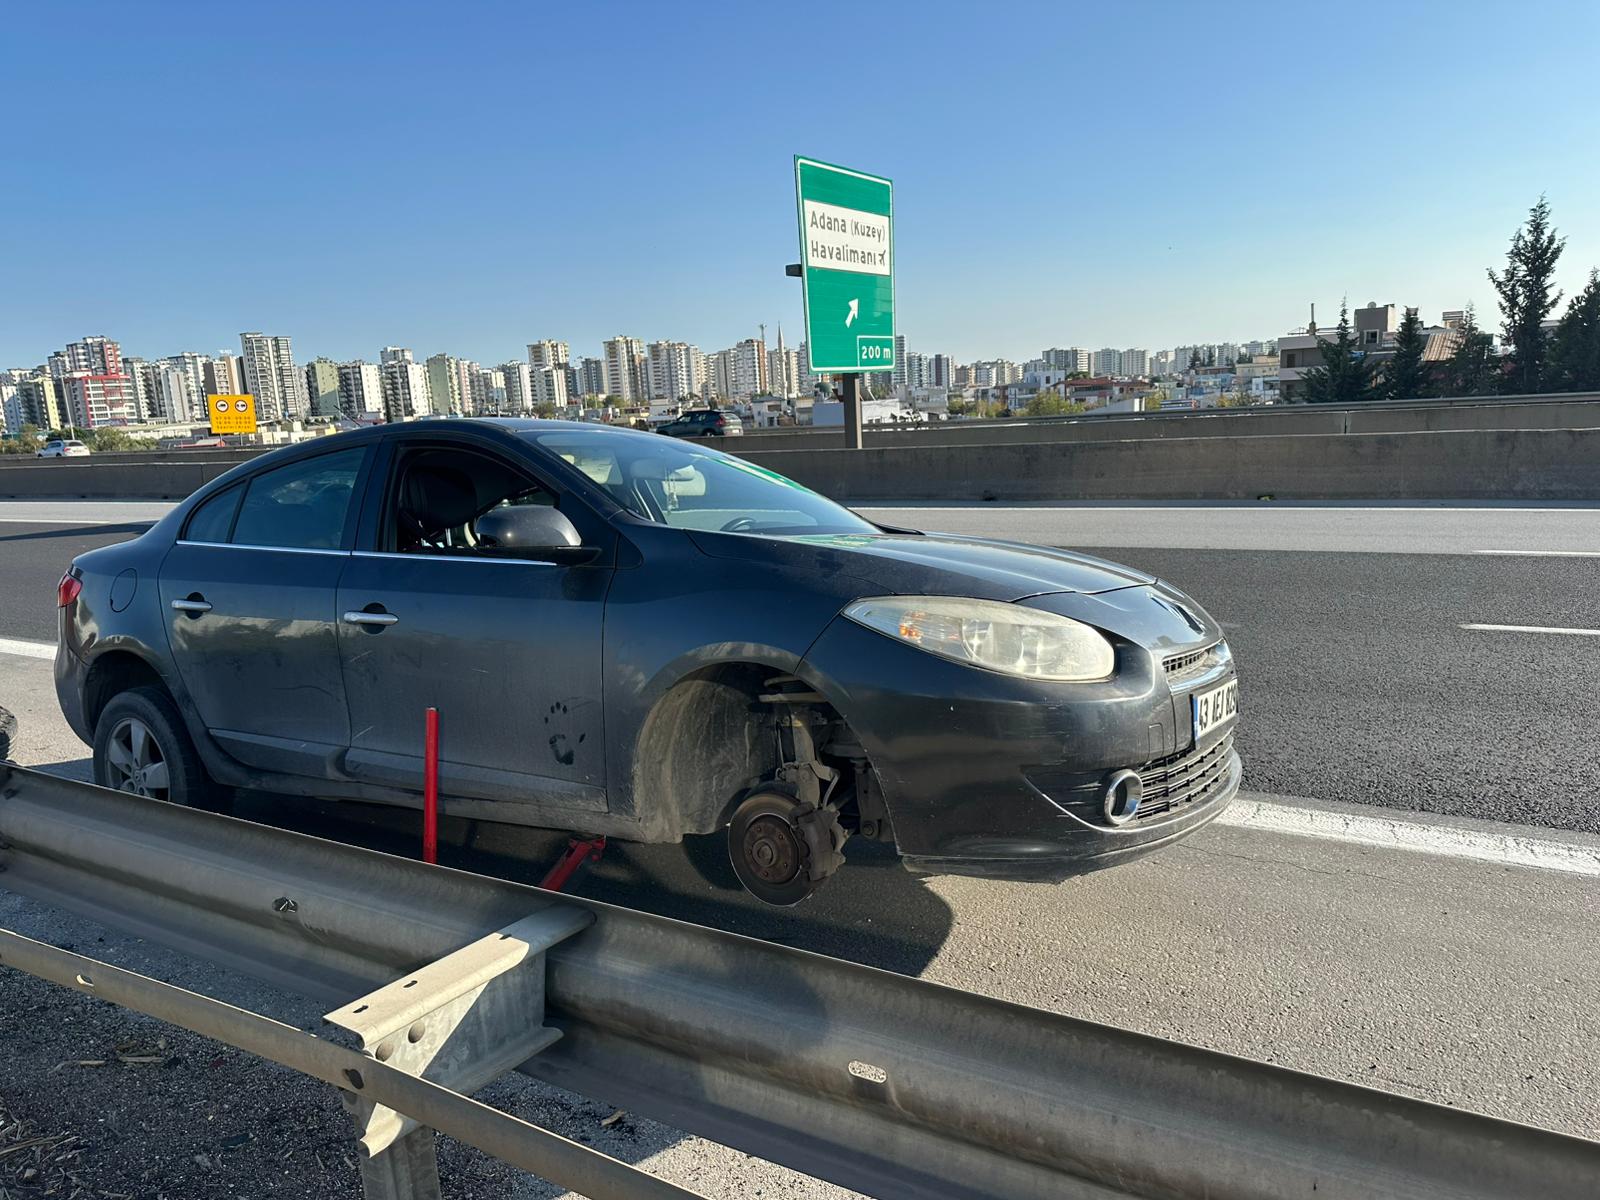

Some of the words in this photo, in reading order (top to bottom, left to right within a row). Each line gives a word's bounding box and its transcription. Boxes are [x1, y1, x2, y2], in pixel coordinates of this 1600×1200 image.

[810, 210, 847, 233] Adana
[850, 218, 886, 243] (Kuzey)
[811, 240, 877, 265] Havalimanı
[861, 345, 880, 359] 200
[883, 347, 891, 359] m
[1199, 697, 1209, 731] 43
